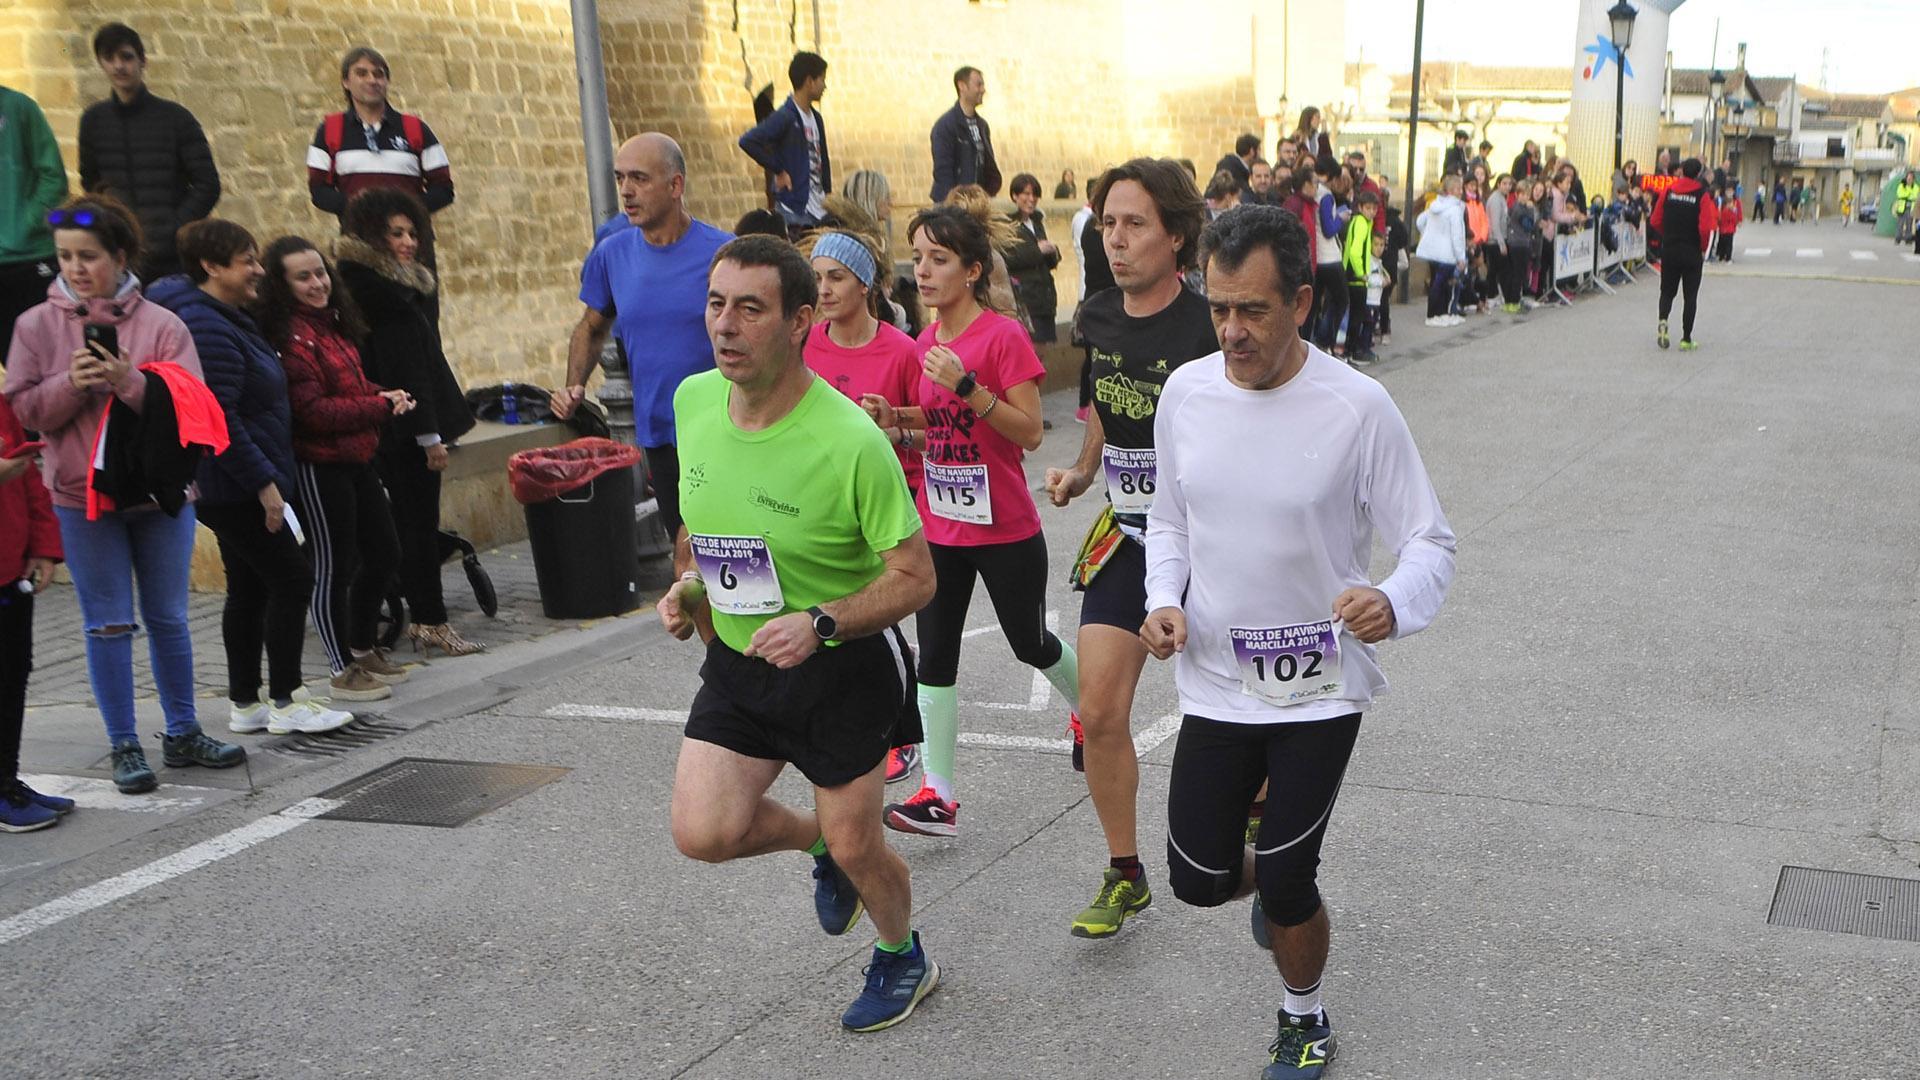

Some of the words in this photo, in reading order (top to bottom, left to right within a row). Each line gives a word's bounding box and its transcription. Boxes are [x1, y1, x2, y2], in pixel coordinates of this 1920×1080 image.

[1099, 391, 1129, 406] TRAIL
[1109, 458, 1139, 468] MARCILLA
[1119, 451, 1129, 460] DE
[1129, 452, 1156, 461] NAVID
[947, 468, 984, 476] NAVIDAD
[1119, 472, 1156, 495] 86
[934, 483, 976, 506] 115
[708, 538, 720, 548] DE
[720, 539, 764, 550] NAVIDAD
[697, 546, 732, 558] MARCILLA
[732, 549, 753, 558] 2019
[719, 562, 738, 590] 6
[1232, 630, 1264, 641] CROSS
[1266, 629, 1282, 640] DE
[1284, 622, 1330, 638] NAVIDAD
[1245, 638, 1296, 650] MARCILLA
[1297, 635, 1320, 647] 2019
[1251, 650, 1324, 683] 102
